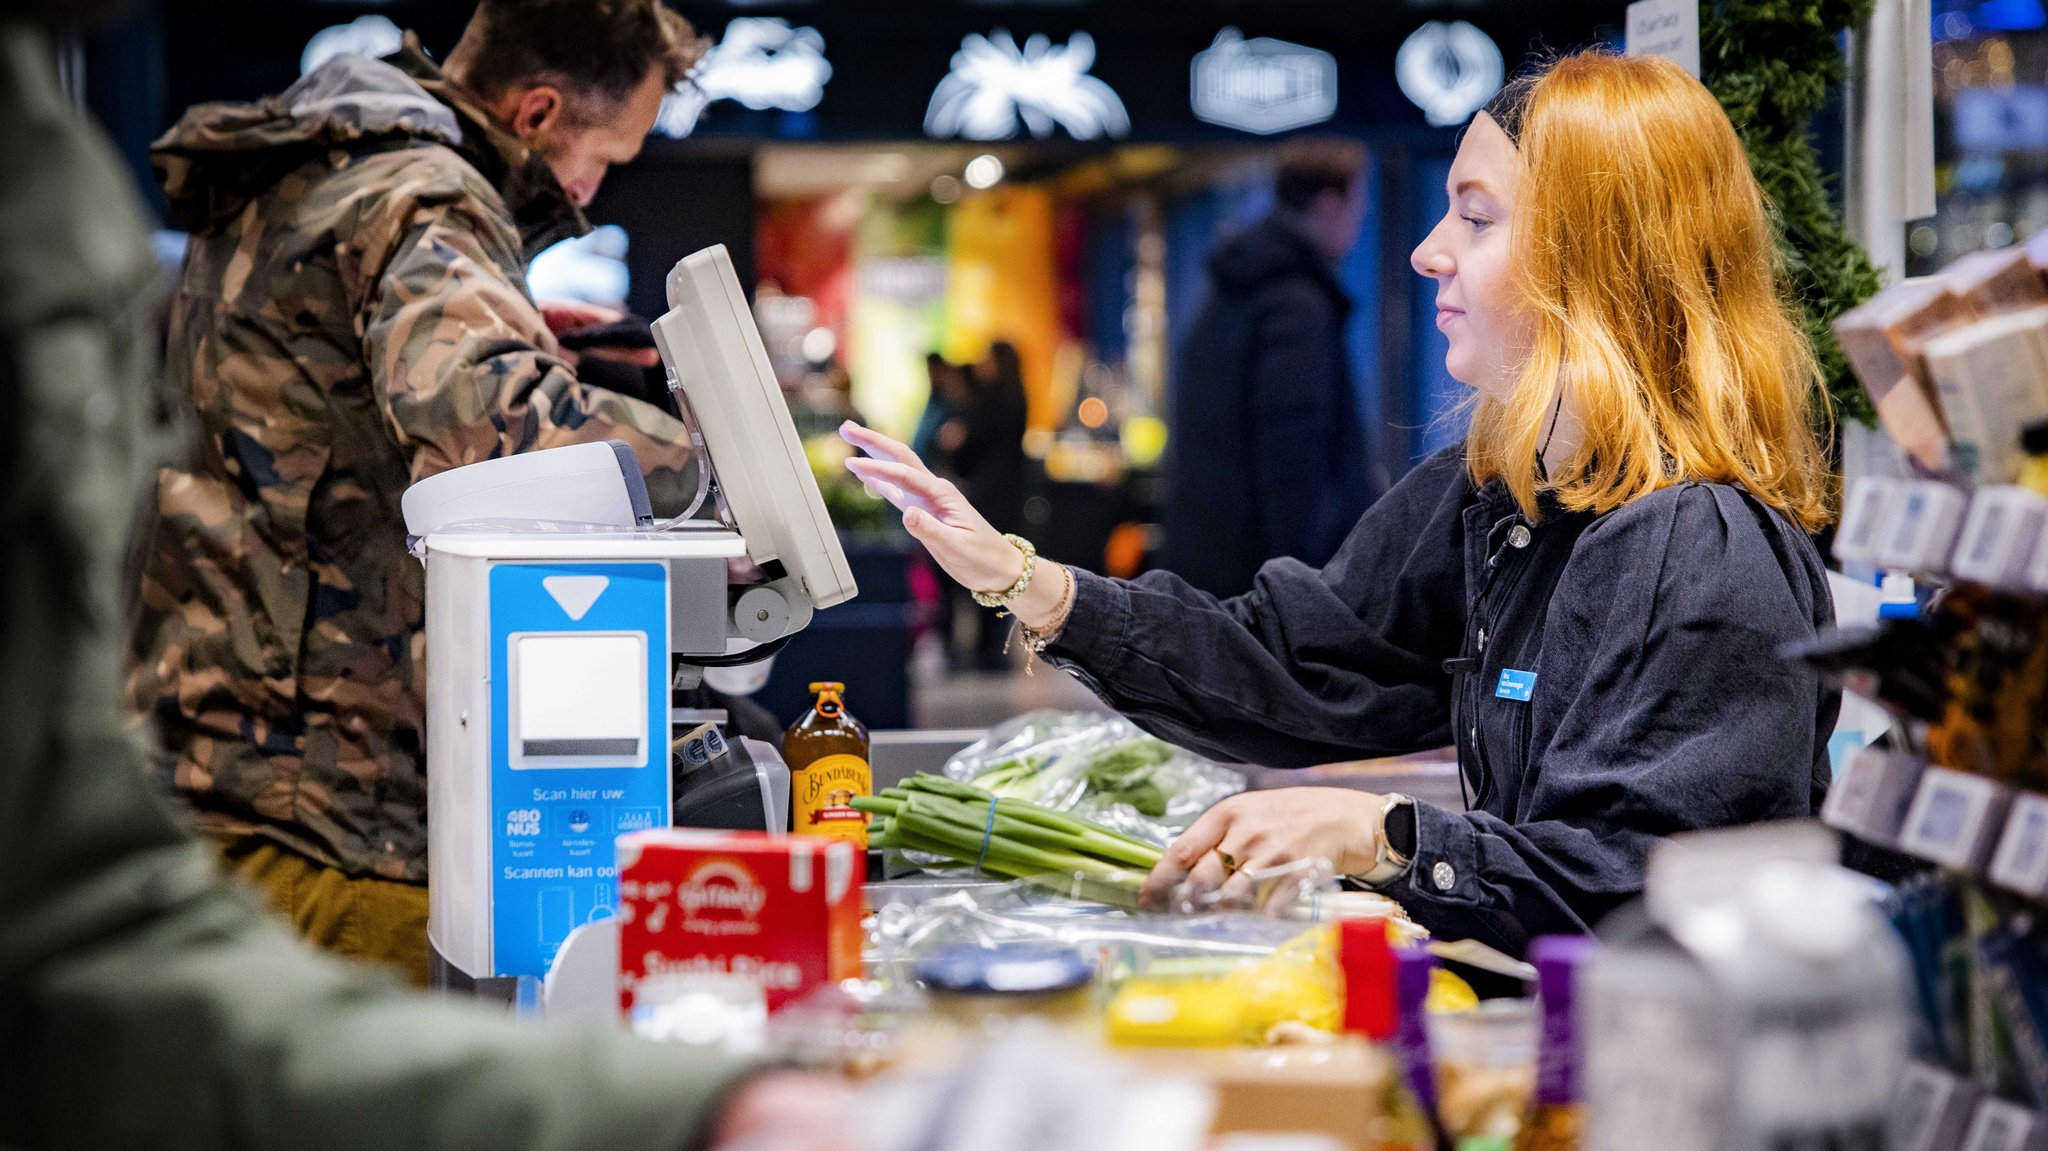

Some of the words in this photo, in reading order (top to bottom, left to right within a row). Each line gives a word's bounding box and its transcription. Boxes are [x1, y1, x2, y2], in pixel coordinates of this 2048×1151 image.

[533, 787, 567, 801] Scan
[571, 787, 597, 800] hier
[504, 866, 563, 880] Scannen
[568, 865, 592, 878] kan
